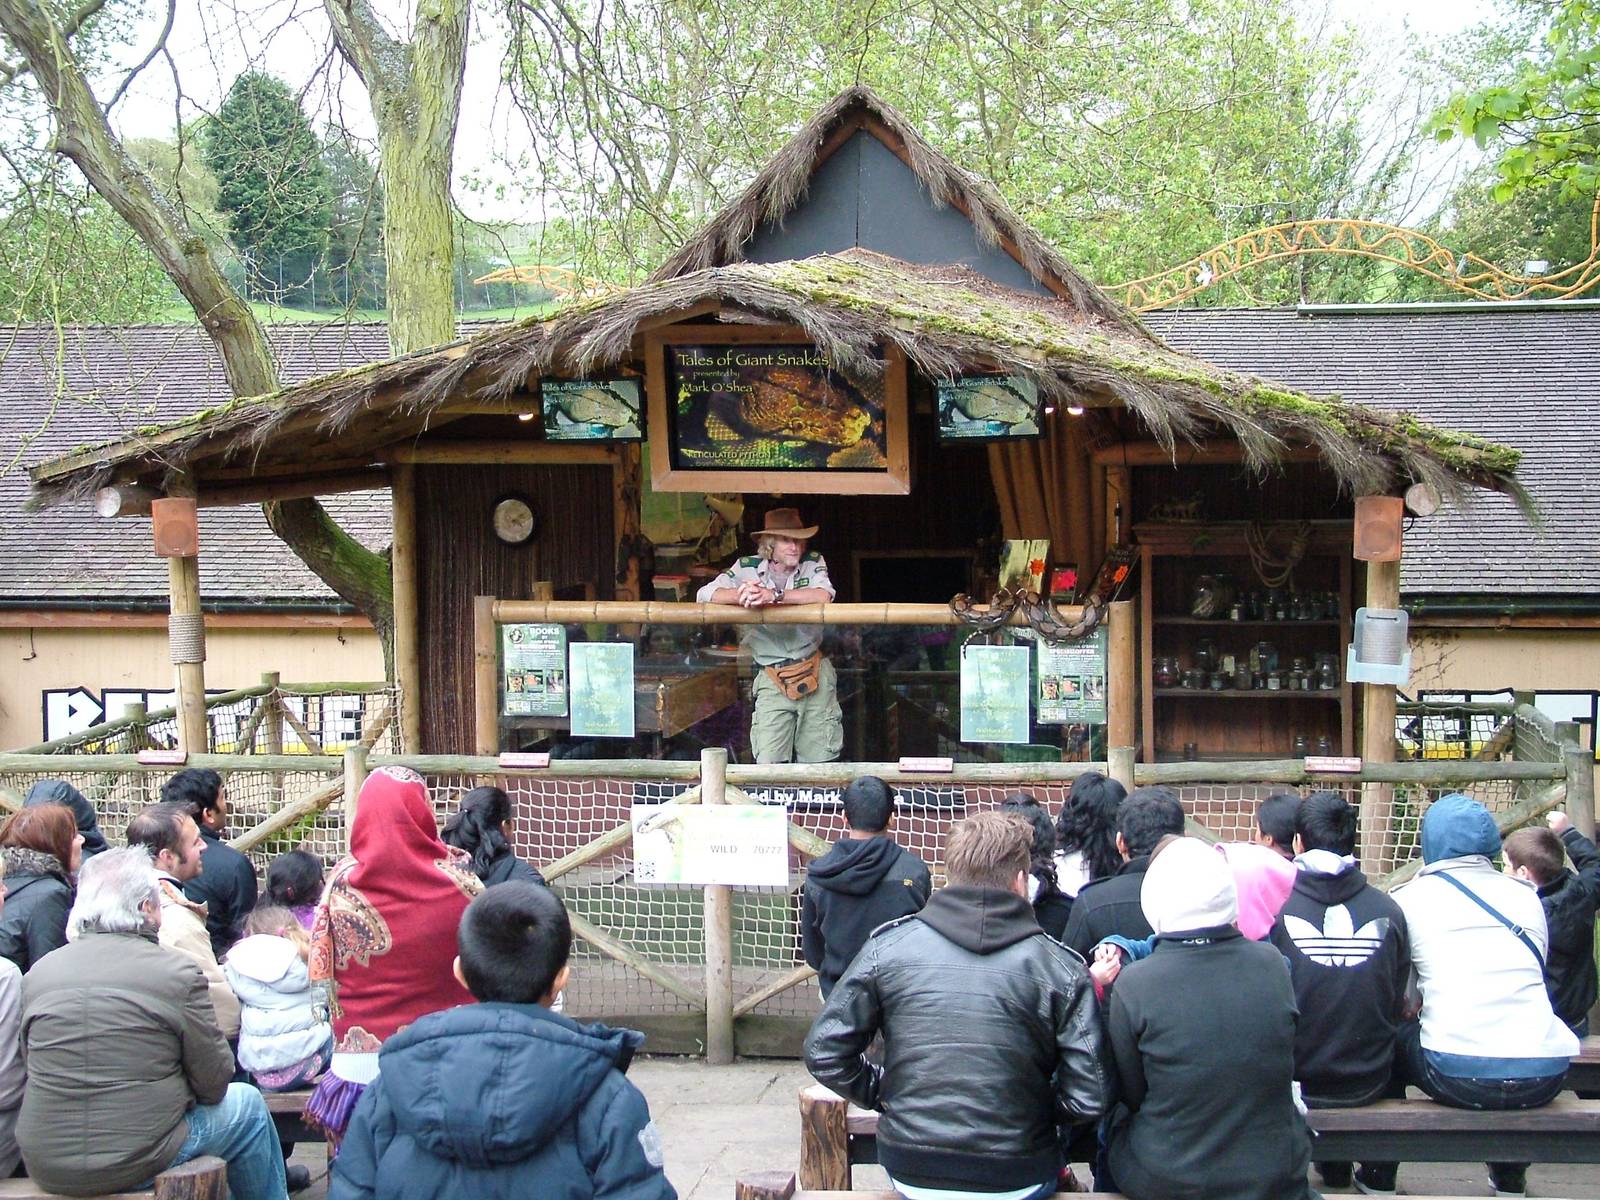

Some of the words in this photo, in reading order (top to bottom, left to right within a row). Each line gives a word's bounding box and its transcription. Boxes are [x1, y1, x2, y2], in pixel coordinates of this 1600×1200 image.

[678, 350, 713, 366] Tales
[717, 350, 732, 366] of
[736, 353, 774, 366] Giant
[777, 350, 829, 366] Snakes
[693, 369, 730, 380] presented
[731, 369, 740, 379] by
[682, 380, 709, 393] Mark
[712, 380, 753, 393] O'Shea
[688, 451, 737, 459] RETICULATED
[739, 451, 771, 459] PYTHON
[774, 790, 795, 805] by
[798, 790, 843, 804] Mark
[710, 844, 738, 854] WILD
